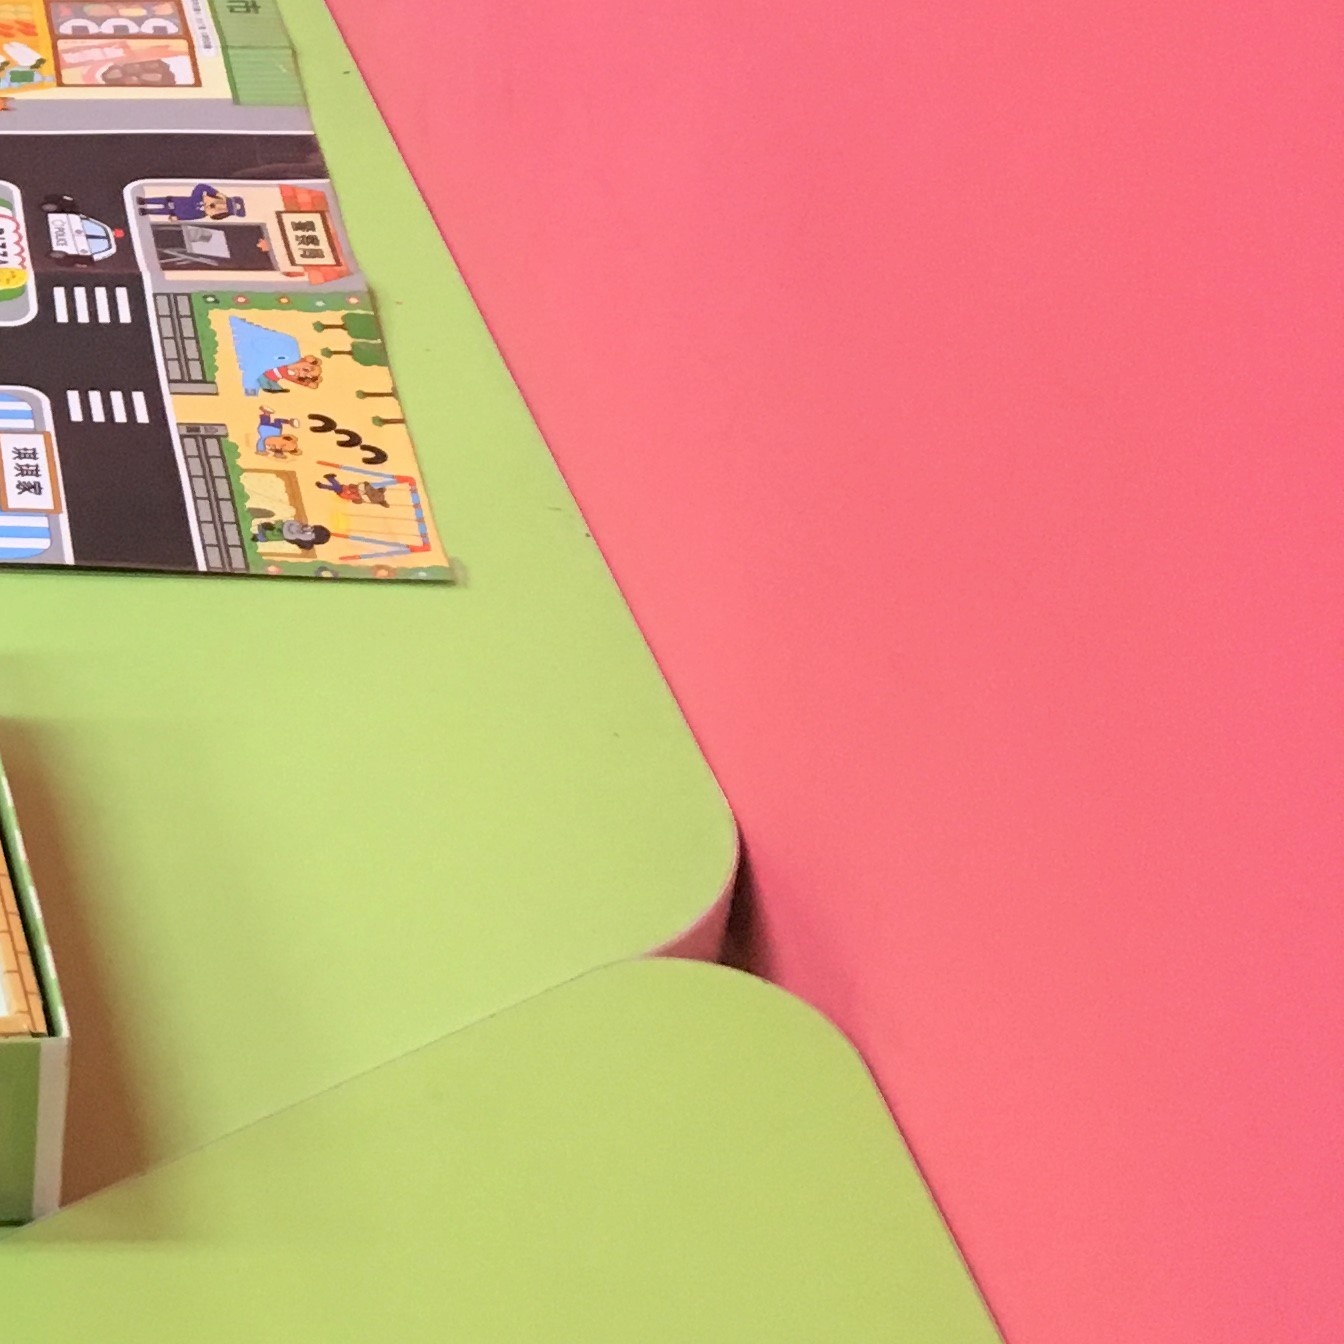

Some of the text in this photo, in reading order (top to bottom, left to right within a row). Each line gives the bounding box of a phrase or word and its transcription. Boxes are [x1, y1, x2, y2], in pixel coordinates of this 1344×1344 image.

[55, 227, 67, 246] POLICE
[13, 447, 42, 495] 琪琪家
